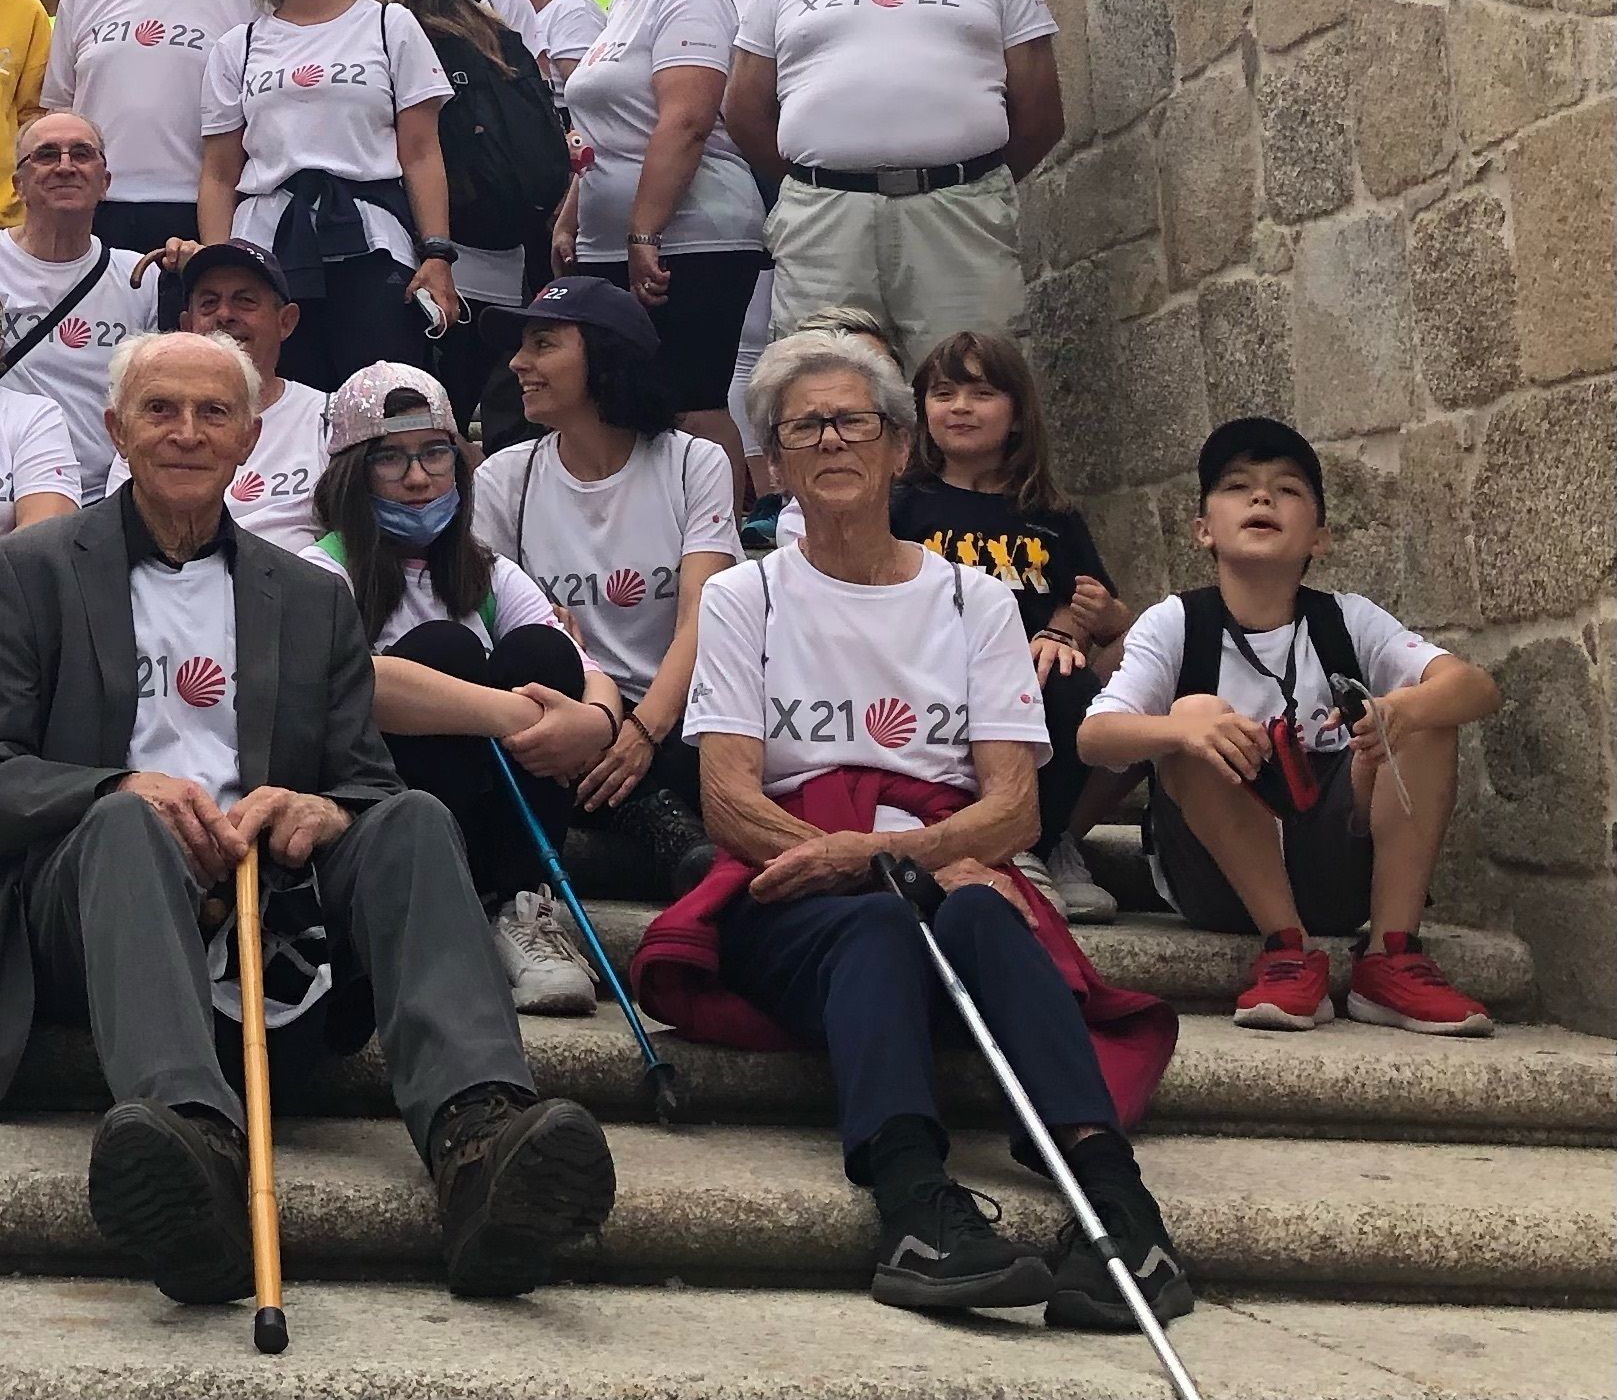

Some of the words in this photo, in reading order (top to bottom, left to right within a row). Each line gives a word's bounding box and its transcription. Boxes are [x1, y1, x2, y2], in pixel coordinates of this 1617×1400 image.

[91, 21, 130, 45] X21
[169, 24, 205, 51] 22
[245, 69, 284, 103] X21
[330, 63, 367, 86] 22
[542, 288, 568, 300] 22
[270, 468, 310, 497] 22
[538, 573, 598, 607] X21
[769, 697, 855, 742] X21
